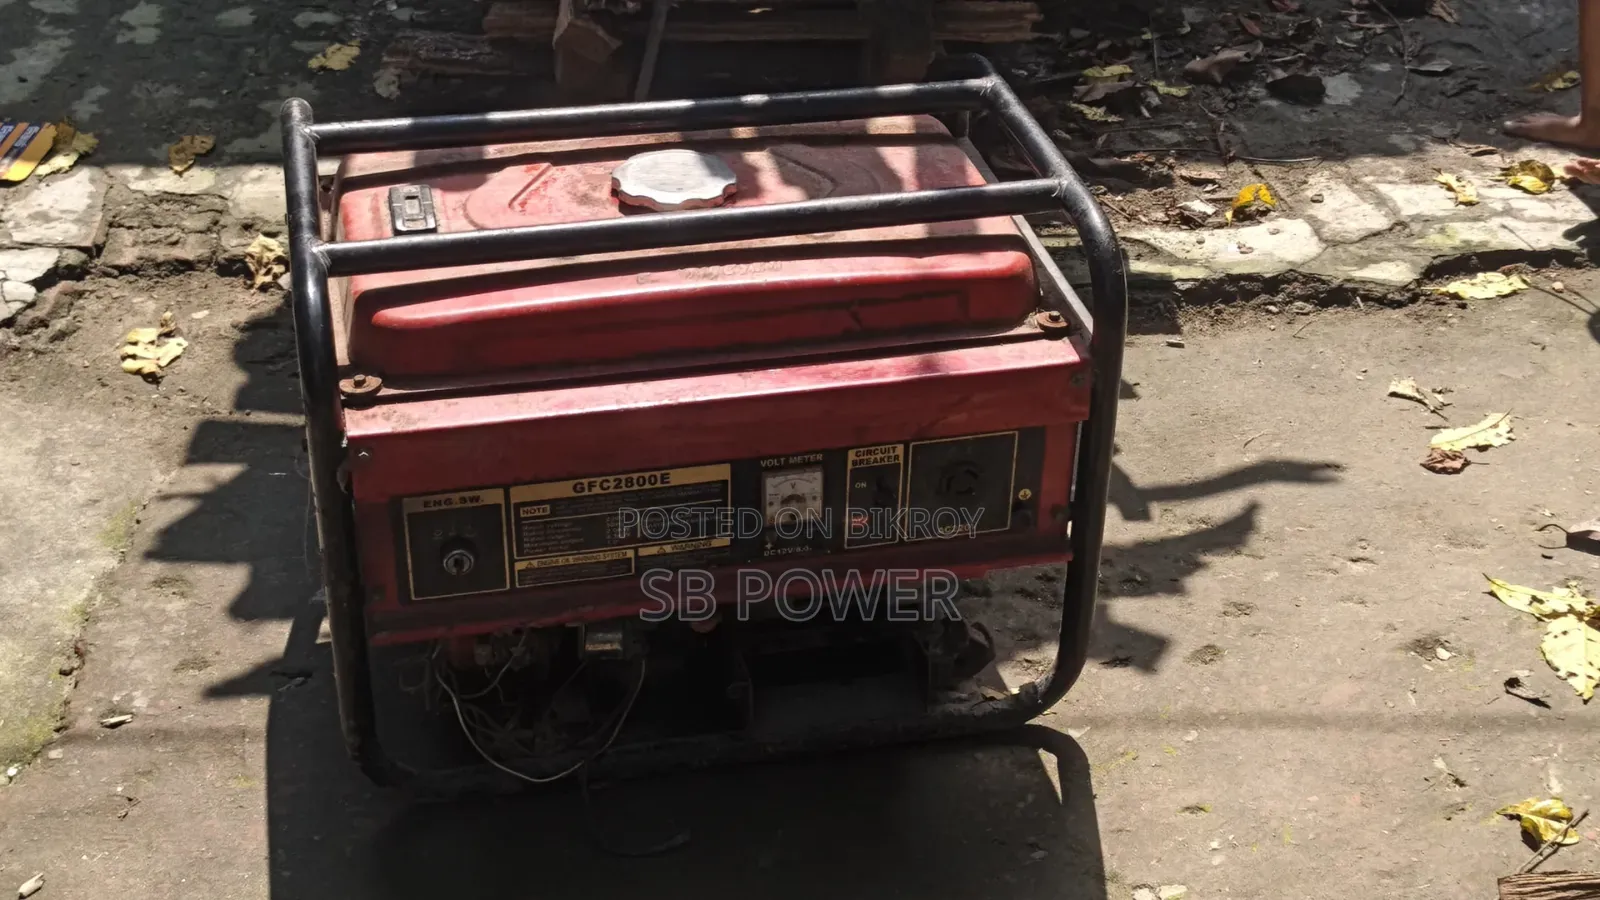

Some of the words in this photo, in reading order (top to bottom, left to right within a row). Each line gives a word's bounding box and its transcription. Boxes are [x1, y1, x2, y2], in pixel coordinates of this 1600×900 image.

[855, 446, 897, 458] CIRCUIT
[760, 457, 785, 468] VOLT
[788, 453, 823, 464] METER
[851, 454, 900, 467] BREAKER
[572, 472, 672, 495] GFC2800E
[854, 481, 867, 489] ON
[423, 495, 484, 508] ENG.SW.
[521, 506, 549, 515] NOTE
